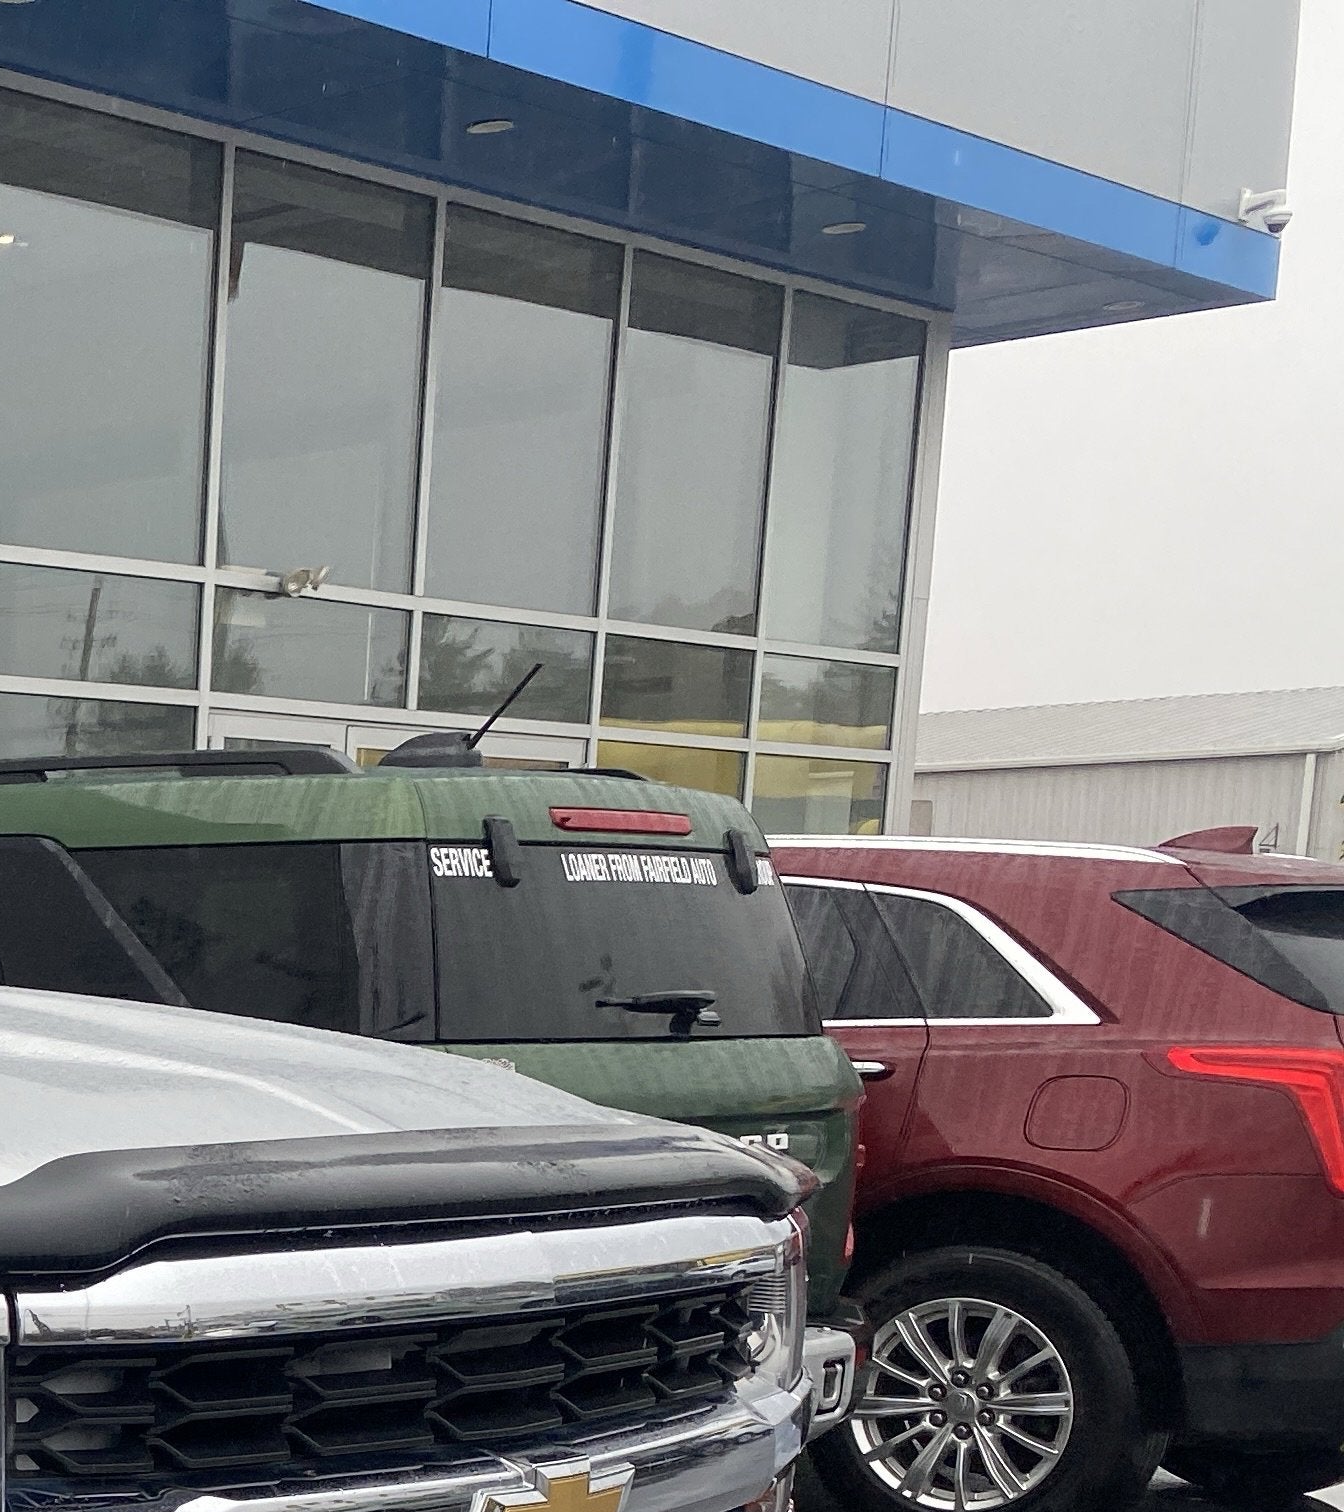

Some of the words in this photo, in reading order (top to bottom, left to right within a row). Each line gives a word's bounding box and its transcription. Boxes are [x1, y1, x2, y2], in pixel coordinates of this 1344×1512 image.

[430, 847, 494, 878] SERVICE
[560, 853, 611, 882] LOANER
[608, 853, 644, 882] FROM
[640, 854, 692, 884] FAIRFIELD
[690, 857, 718, 886] AUTO
